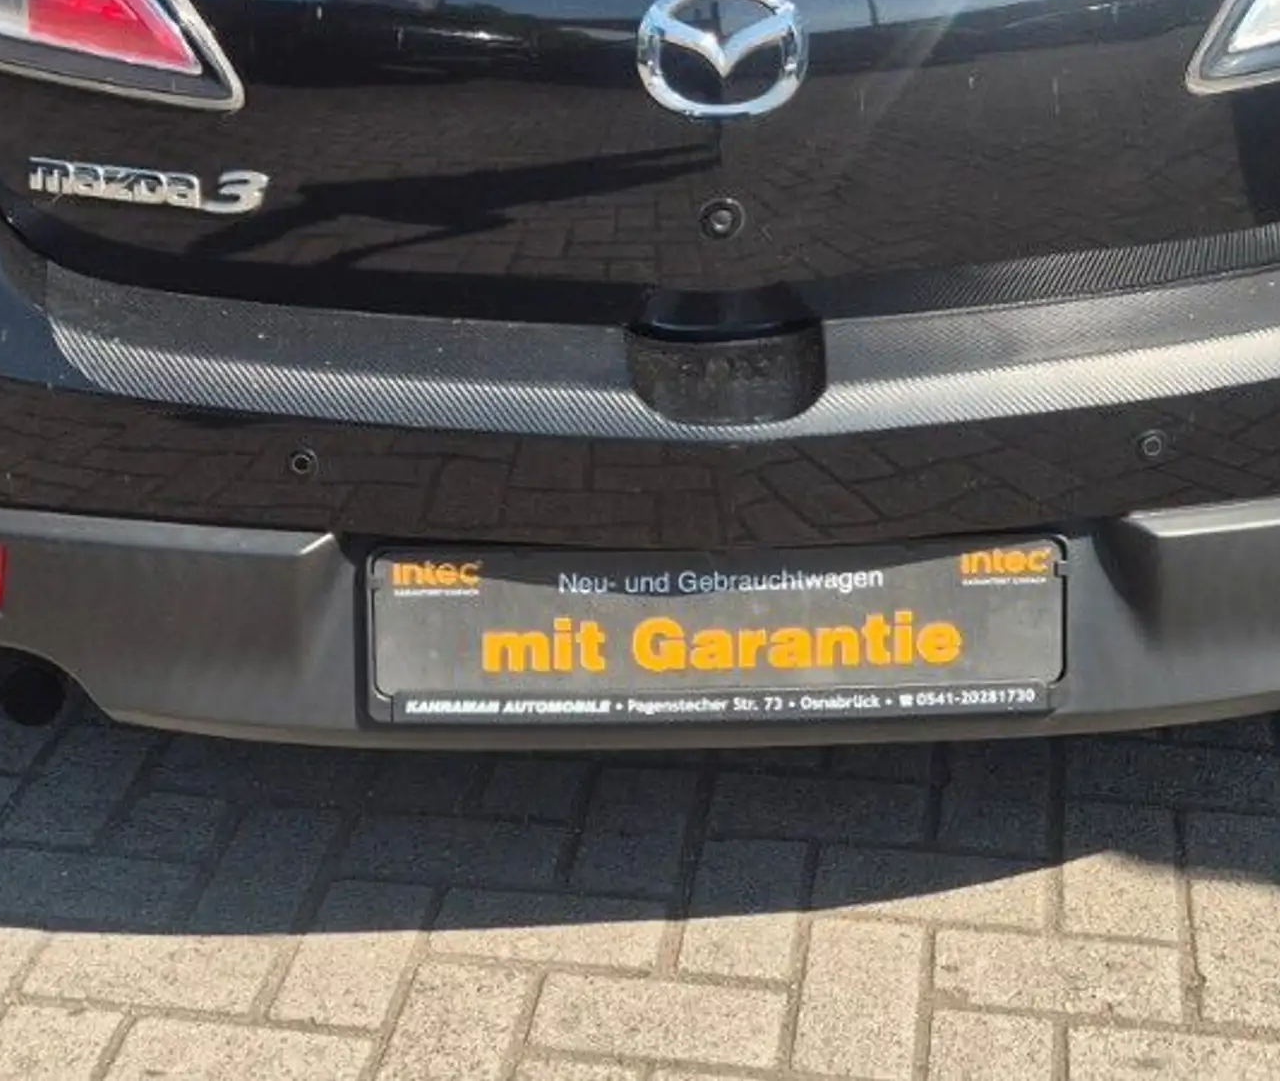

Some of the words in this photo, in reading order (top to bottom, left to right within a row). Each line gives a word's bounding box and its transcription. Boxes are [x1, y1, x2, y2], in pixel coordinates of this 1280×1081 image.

[558, 572, 616, 594] Neu-
[625, 571, 670, 593] und
[677, 569, 884, 593] Gebrauchtwagen
[481, 617, 605, 672] mit
[632, 611, 962, 672] Garantie
[627, 697, 728, 715] Pagenstecher
[733, 697, 759, 711] Str.
[764, 696, 782, 711] 73
[800, 693, 881, 710] Osnabrück
[916, 688, 1036, 706] 0541-20281730
